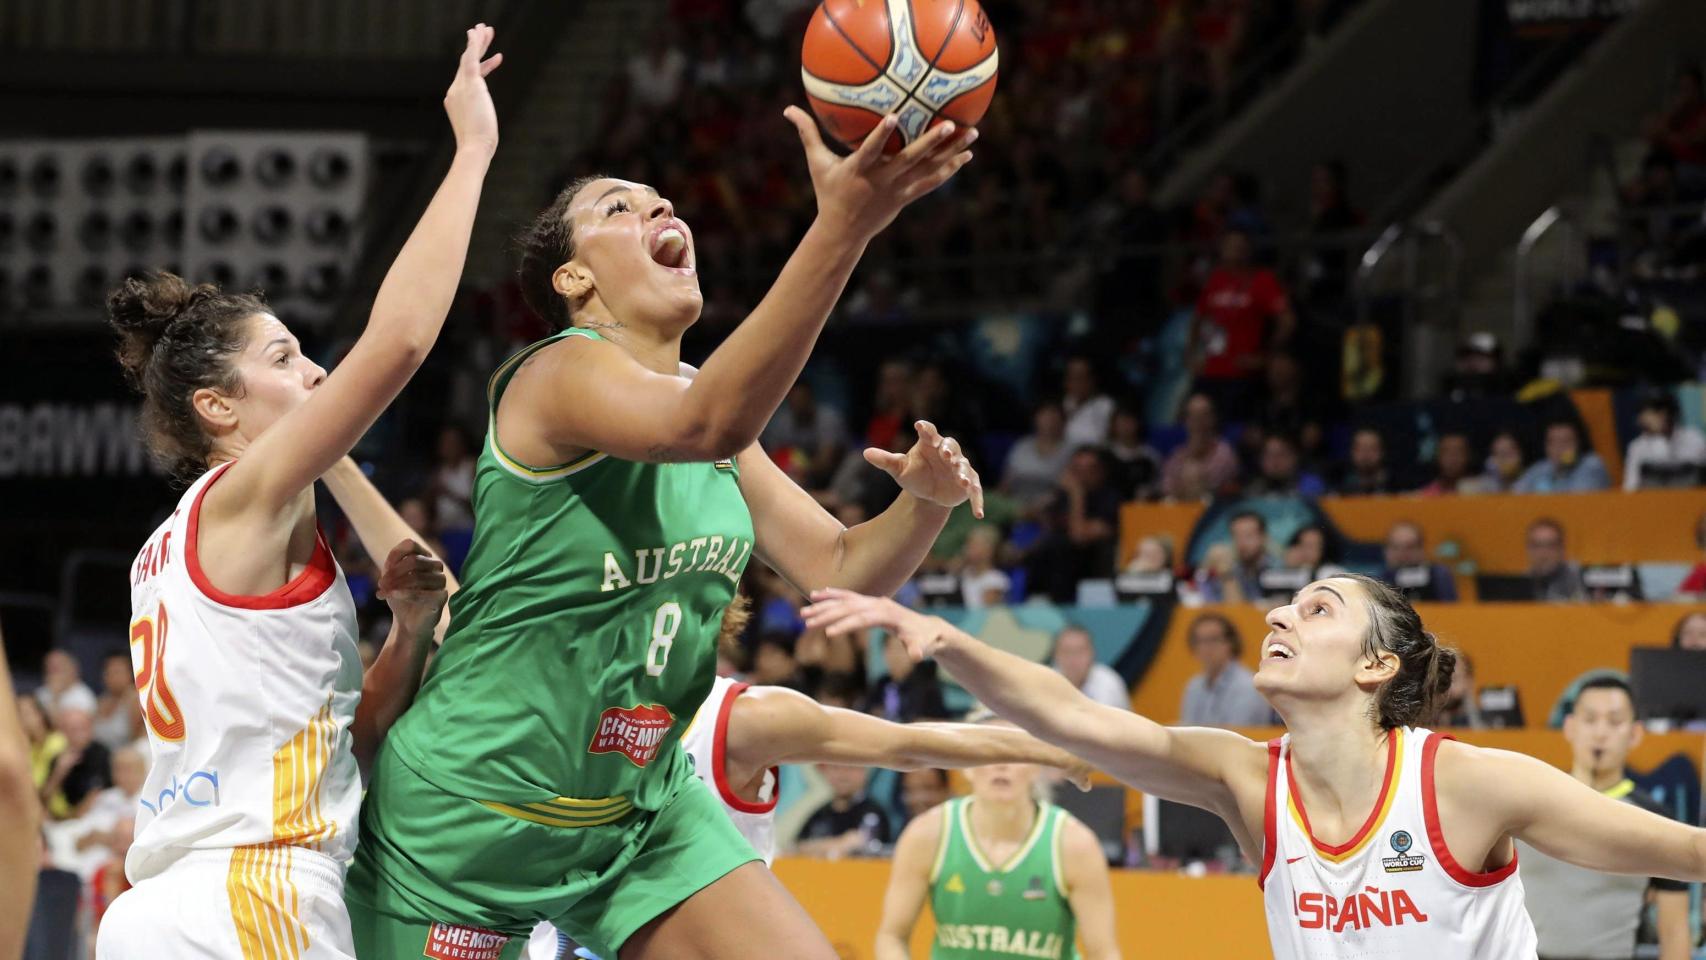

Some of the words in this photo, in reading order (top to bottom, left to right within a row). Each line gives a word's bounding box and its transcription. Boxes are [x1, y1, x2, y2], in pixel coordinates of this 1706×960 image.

[601, 535, 750, 592] AUSTRAL
[646, 602, 682, 677] 8
[1384, 860, 1409, 868] WORLD
[1293, 884, 1428, 933] SPAÑA
[432, 942, 498, 960] WAREHOUSE
[434, 922, 508, 949] CHEMIST
